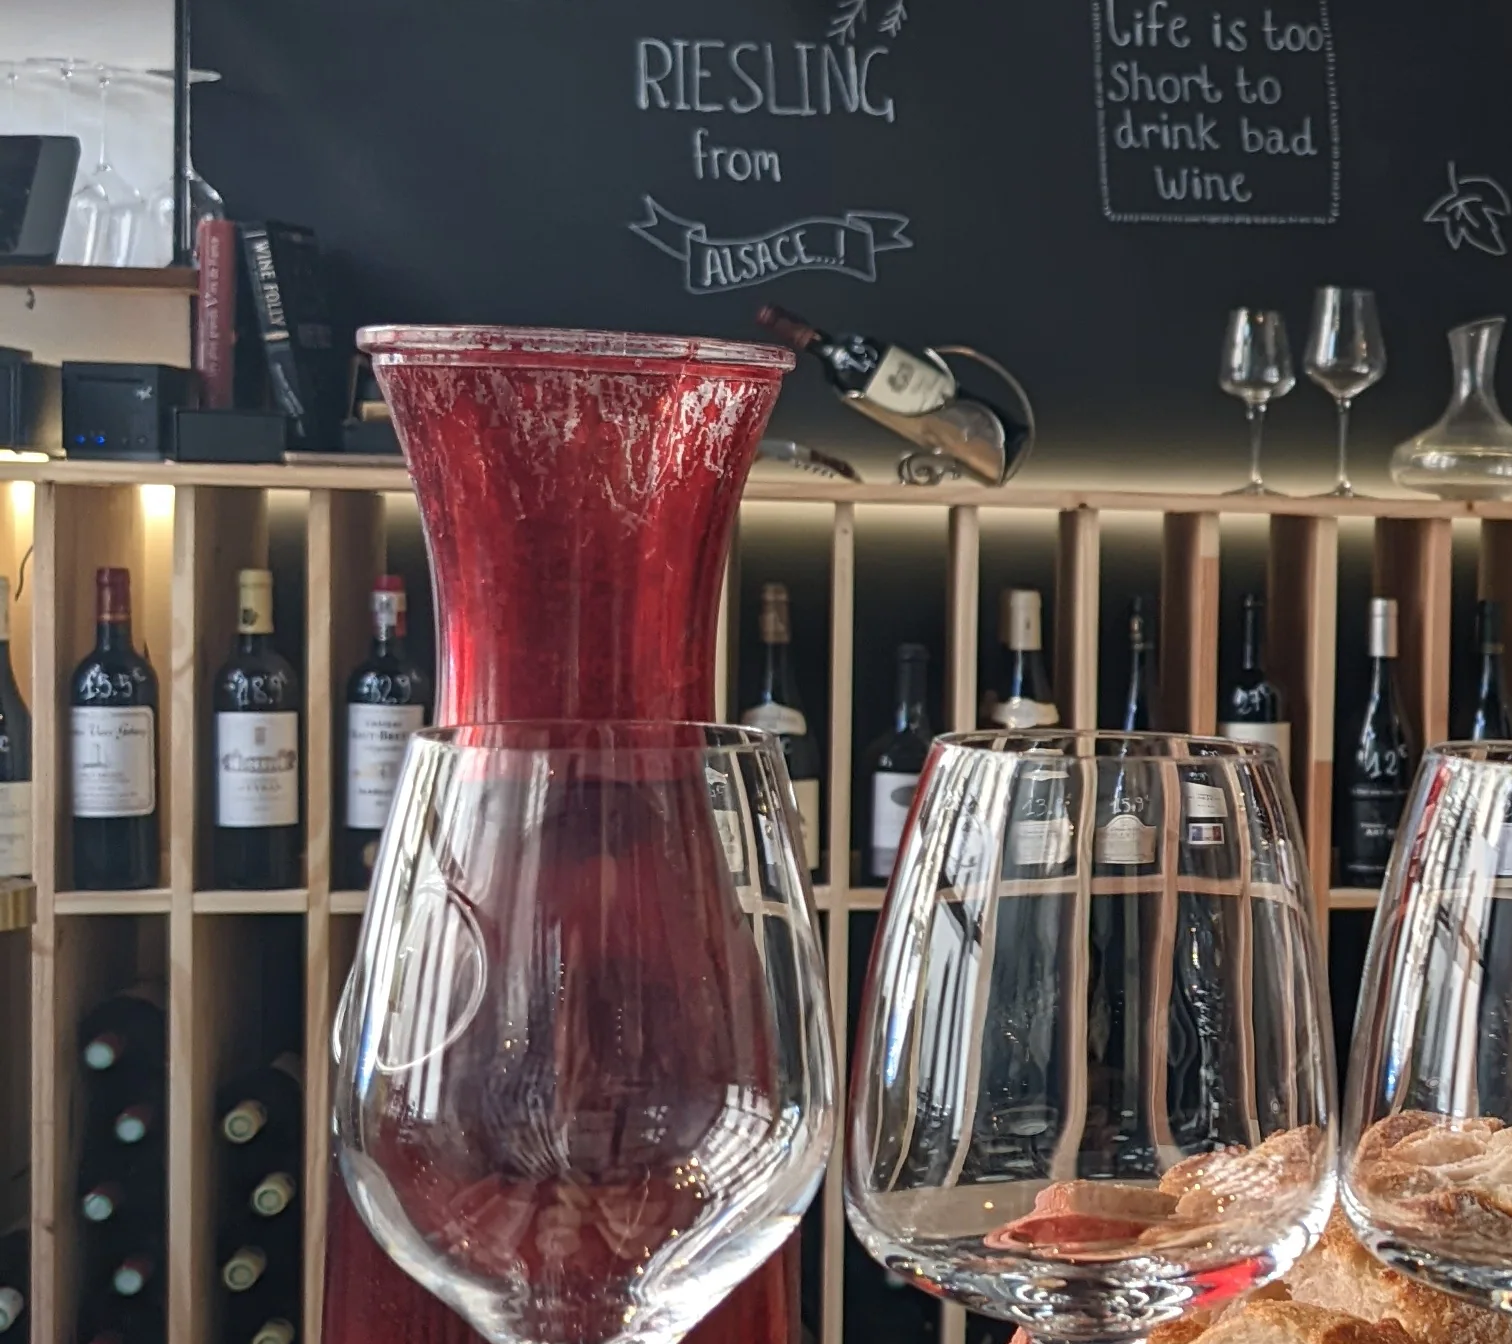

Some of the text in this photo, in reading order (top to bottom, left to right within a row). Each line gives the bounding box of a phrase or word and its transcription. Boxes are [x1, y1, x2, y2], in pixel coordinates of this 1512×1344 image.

[1261, 7, 1325, 52] too
[636, 33, 895, 123] RIESLING
[693, 127, 782, 183] from
[1115, 109, 1318, 156] drink bad
